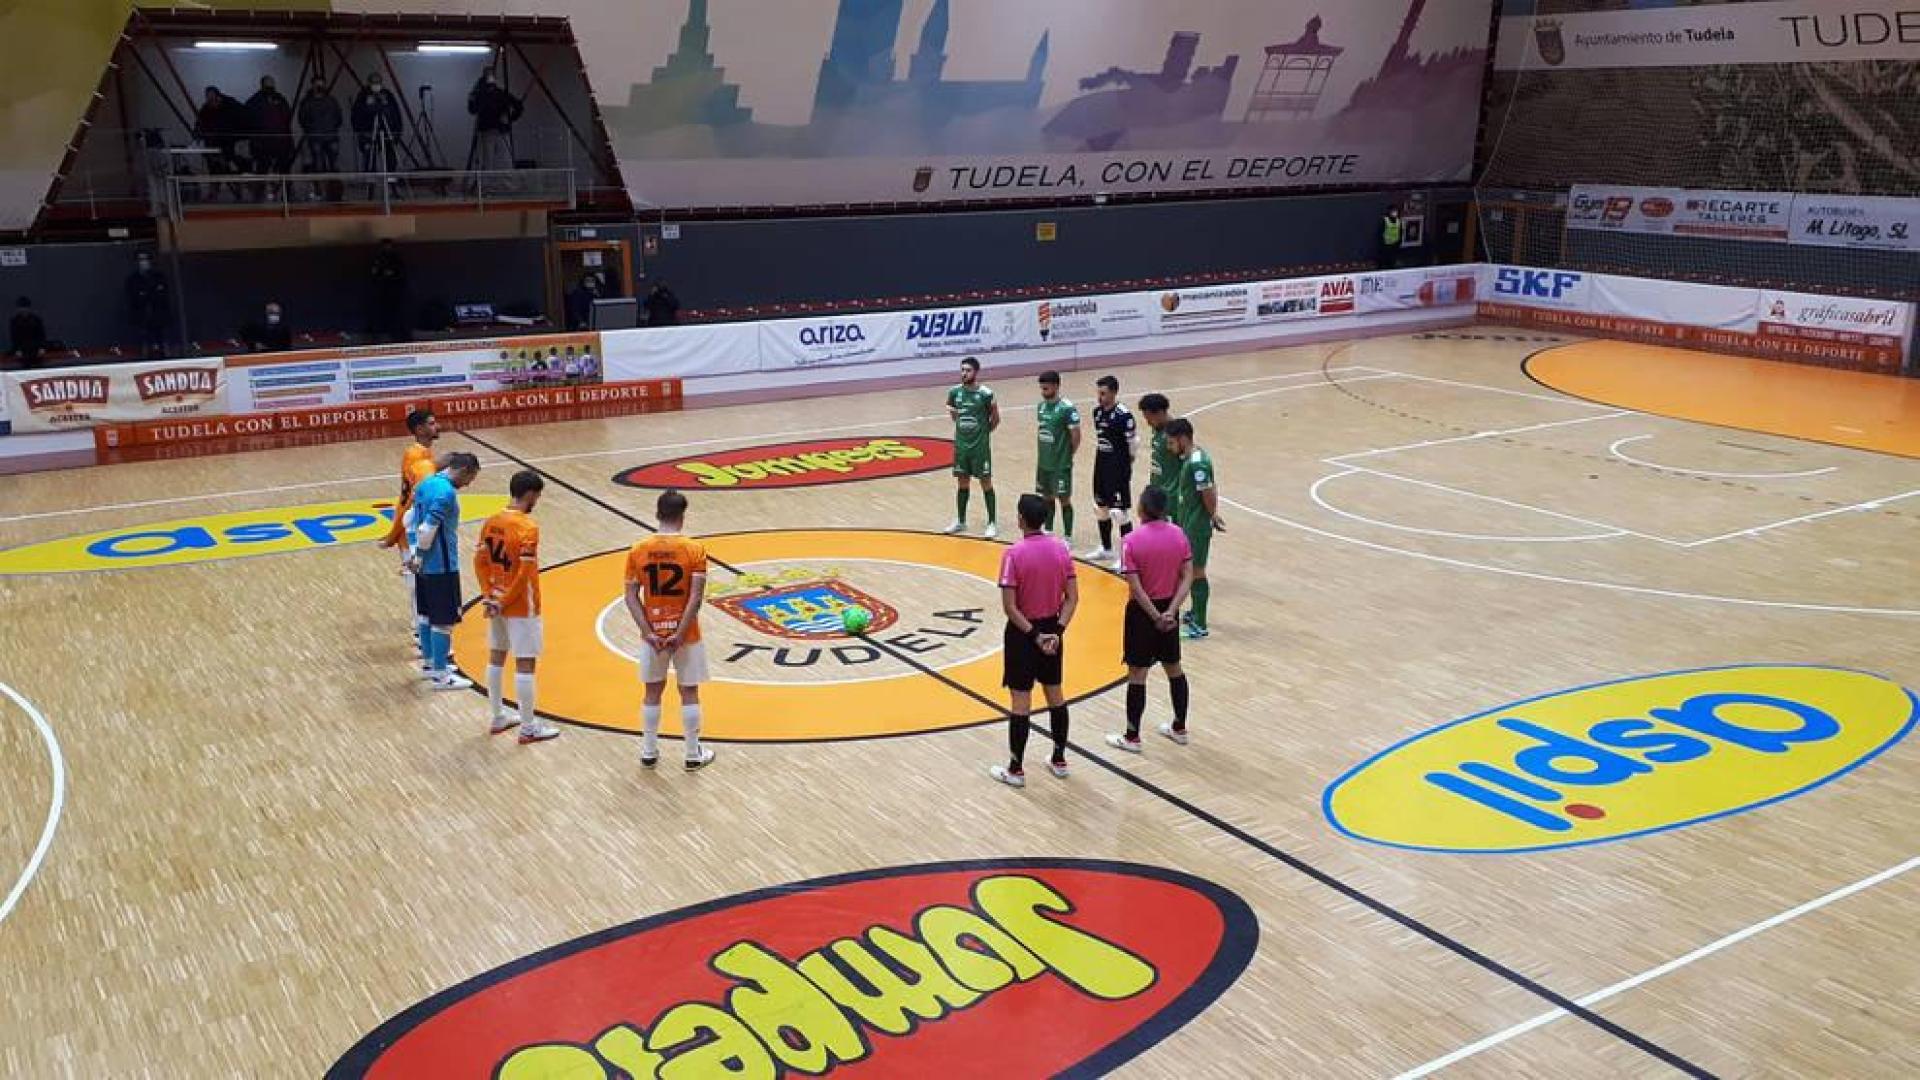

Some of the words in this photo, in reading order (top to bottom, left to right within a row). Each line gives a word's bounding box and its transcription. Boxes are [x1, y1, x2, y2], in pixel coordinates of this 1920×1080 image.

[1575, 33, 1663, 48] Ayuntamiento
[1666, 31, 1682, 44] de
[1683, 28, 1735, 42] Tudela
[950, 164, 1084, 190] TUDELA,
[1101, 161, 1173, 184] CON
[1182, 159, 1214, 180] EL
[1227, 155, 1359, 179] DEPORTE
[1495, 267, 1581, 297] SKF
[800, 323, 865, 345] ariza
[1534, 311, 1571, 324] TUDELA
[1574, 316, 1597, 327] CON
[1616, 321, 1663, 336] DEPORTE
[1703, 332, 1749, 346] TUDELA
[1755, 338, 1779, 350] CON
[1784, 342, 1797, 353] EL
[1805, 343, 1864, 360] DEPORTE
[31, 379, 103, 404] SANDUA
[143, 371, 211, 395] SANDUA
[444, 396, 511, 413] TUDELA
[516, 393, 549, 407] CON
[555, 391, 574, 403] EL
[580, 386, 649, 402] DEPORTE
[154, 423, 228, 441] TUDELA
[234, 418, 273, 433] CON
[282, 415, 301, 428] EL
[309, 408, 389, 425] DEPORTE
[86, 503, 402, 557] asp
[484, 536, 513, 573] 14
[643, 562, 686, 597] 12
[724, 608, 984, 667] TUDELA
[1423, 693, 1840, 832] aspil
